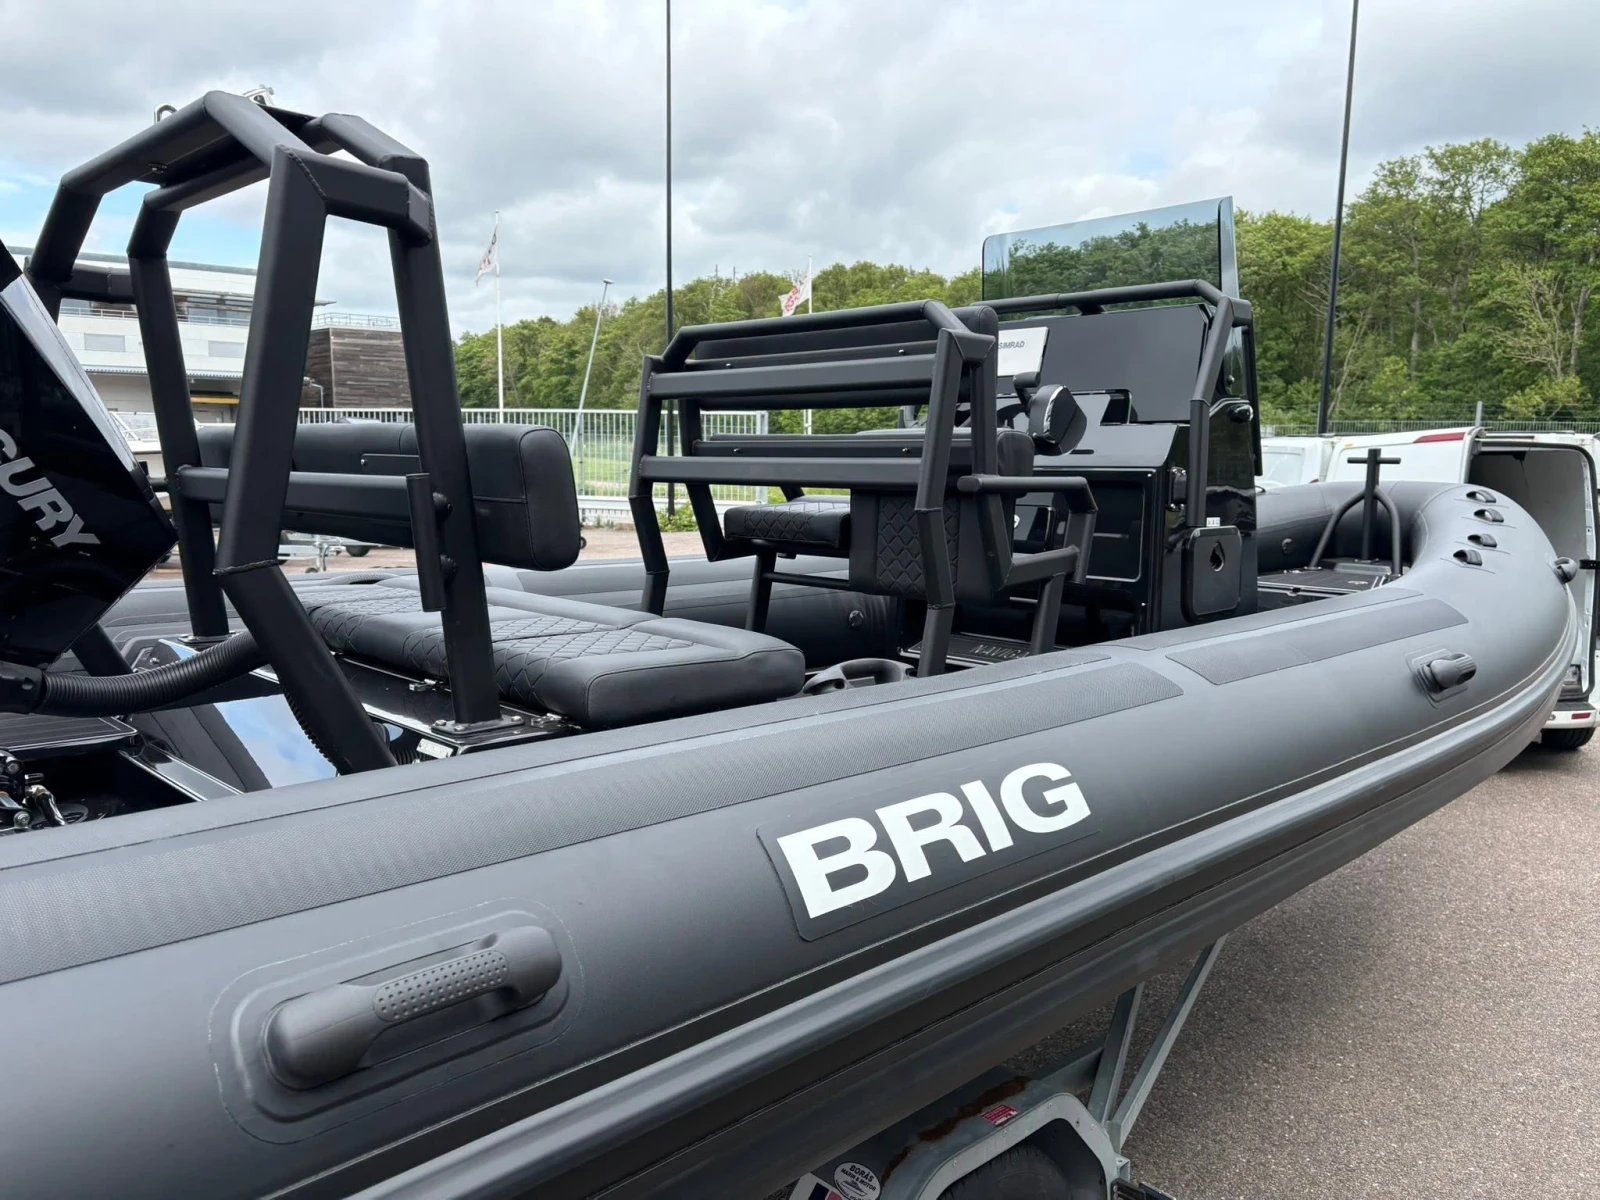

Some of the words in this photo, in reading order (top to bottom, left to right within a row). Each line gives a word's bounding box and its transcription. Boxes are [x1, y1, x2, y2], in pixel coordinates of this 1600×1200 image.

[998, 341, 1026, 350] SIMRAD
[776, 762, 1092, 919] BRIG
[840, 1168, 856, 1180] MARIN
[859, 1178, 877, 1191] MOTOR
[849, 1164, 875, 1182] BORÅS
